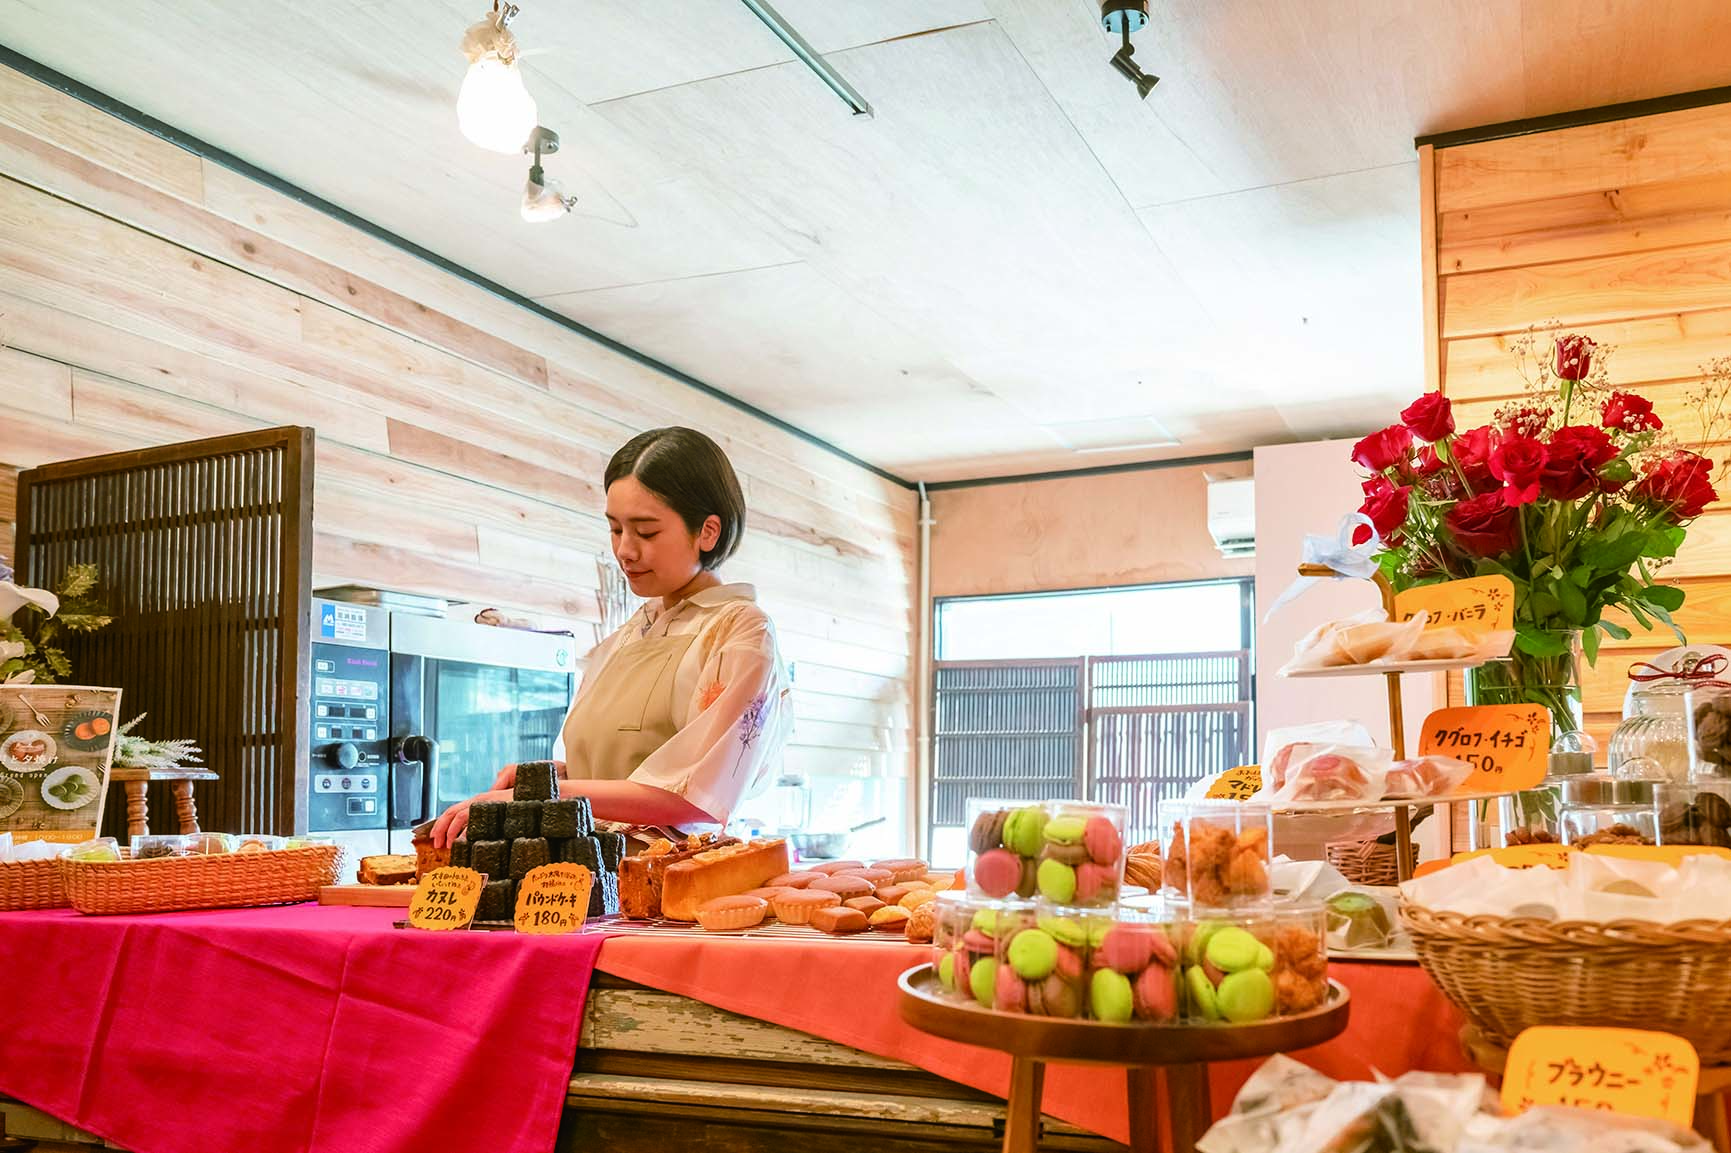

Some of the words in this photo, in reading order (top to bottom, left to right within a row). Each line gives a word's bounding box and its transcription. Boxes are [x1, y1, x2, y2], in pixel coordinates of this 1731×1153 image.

[1434, 727, 1528, 748] クグロフ・イチゴ
[426, 889, 457, 905] カヌレ
[525, 890, 577, 908] パウンドケーキ
[533, 910, 567, 927] 180円
[1547, 1057, 1641, 1088] ブラウニー
